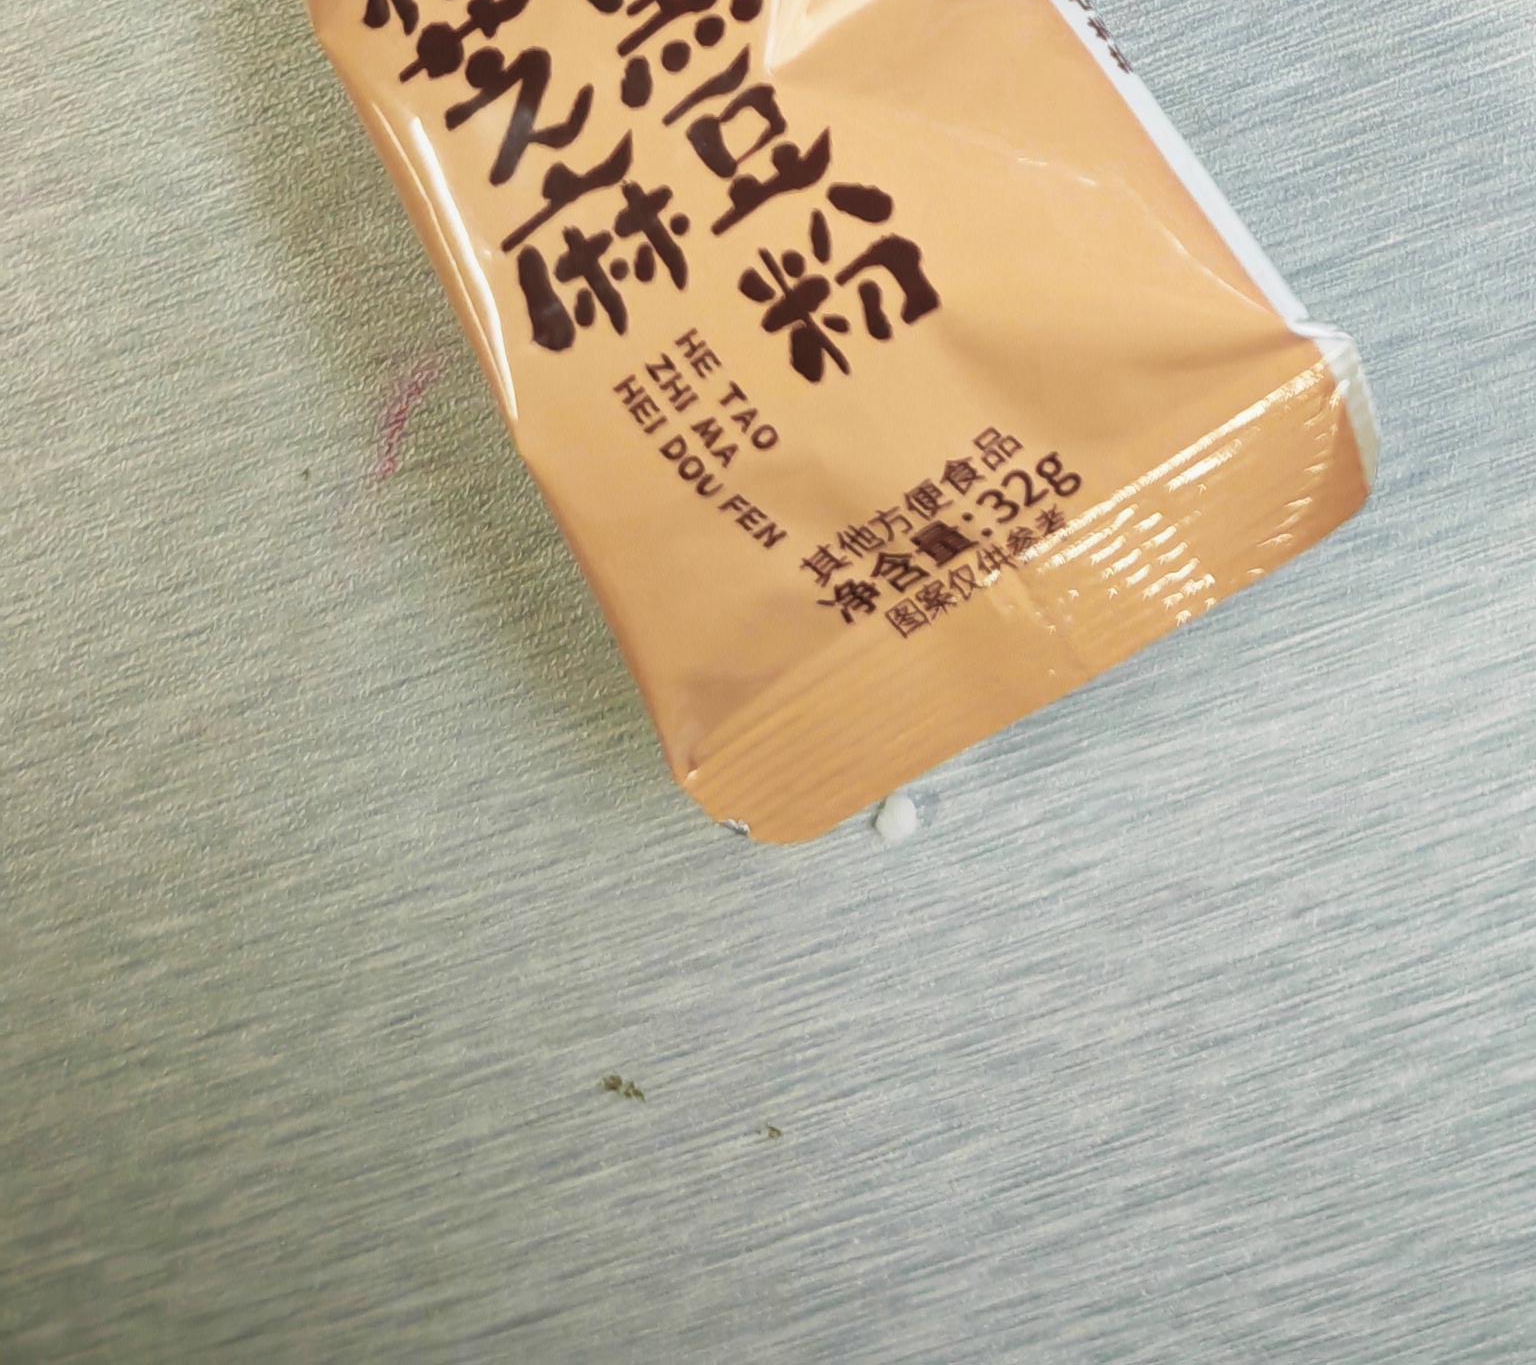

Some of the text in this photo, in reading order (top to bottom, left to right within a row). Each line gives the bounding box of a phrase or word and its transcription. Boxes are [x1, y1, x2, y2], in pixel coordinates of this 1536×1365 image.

[612, 374, 788, 549] HEI DOU FEN
[645, 353, 740, 469] ZHI MA
[674, 327, 778, 451] HE TAO
[800, 425, 1023, 586] 其他方便食品
[816, 450, 1083, 624] 净含量:32g
[884, 503, 1066, 638] 图案仅供参考
